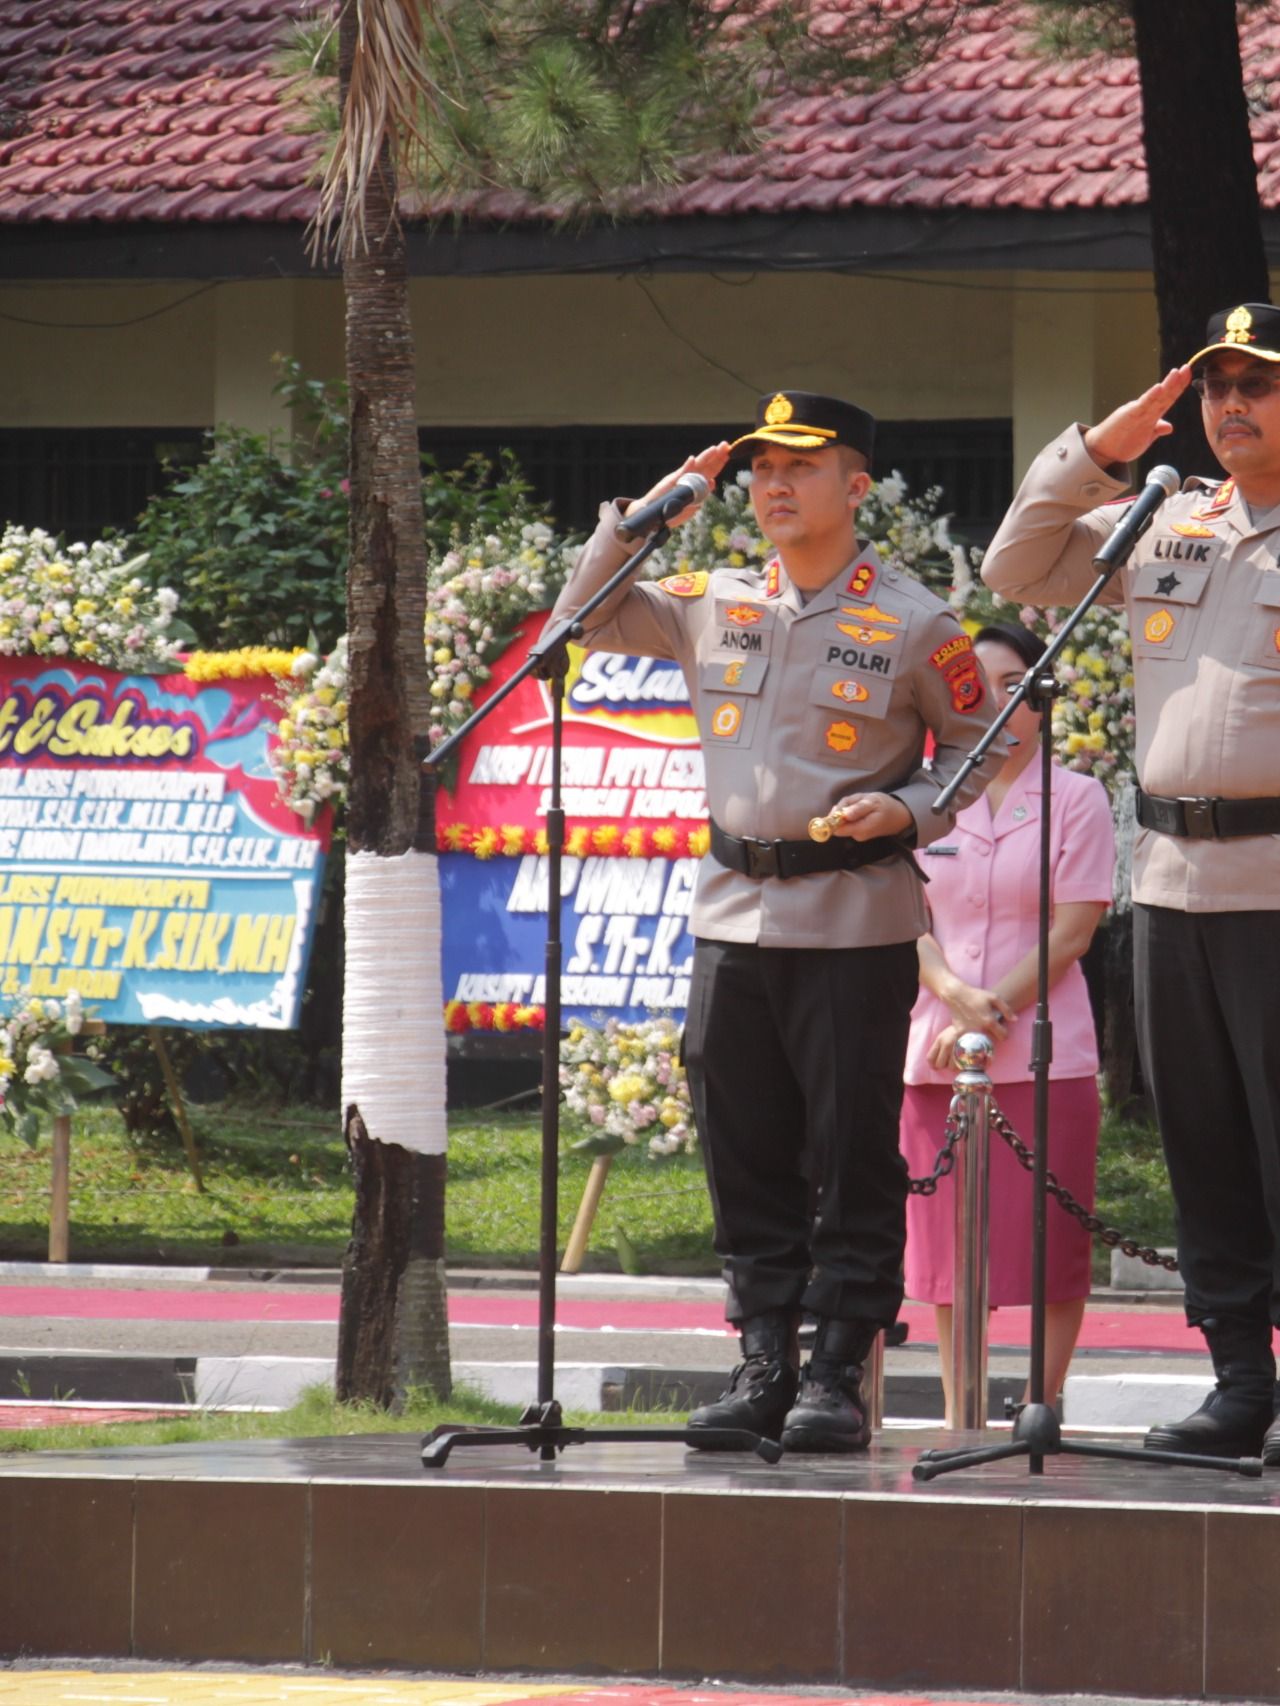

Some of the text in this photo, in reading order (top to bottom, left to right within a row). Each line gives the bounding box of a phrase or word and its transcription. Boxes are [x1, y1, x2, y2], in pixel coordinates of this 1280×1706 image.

[1154, 539, 1211, 562] LILIK
[720, 631, 762, 651] ANOM
[826, 646, 891, 675] POLRI
[48, 698, 193, 758] Sukses
